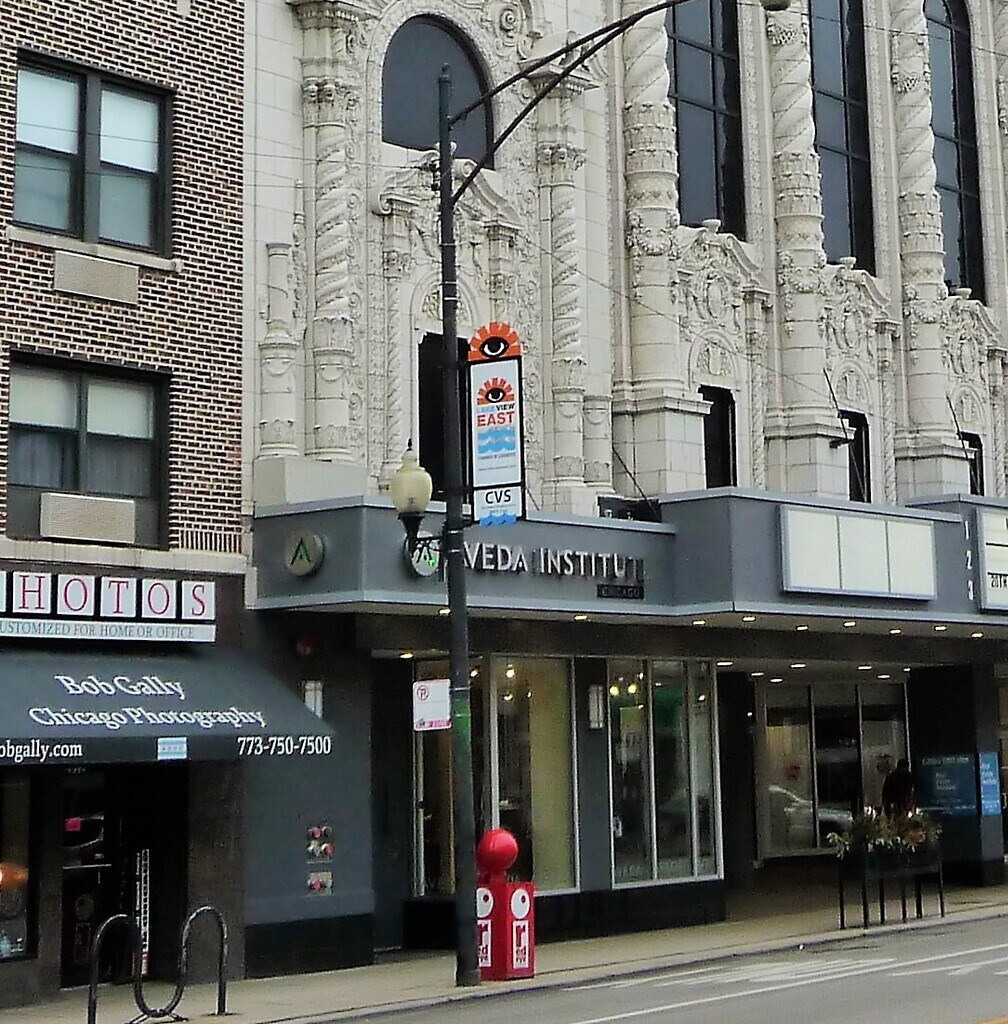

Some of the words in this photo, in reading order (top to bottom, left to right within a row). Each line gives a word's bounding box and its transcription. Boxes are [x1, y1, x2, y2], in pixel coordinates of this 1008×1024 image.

[477, 412, 515, 427] EAST
[485, 489, 511, 504] CVS
[463, 541, 529, 572] VEDA
[74, 623, 96, 636] FOR
[101, 624, 134, 637] HOME
[137, 625, 153, 637] OR
[156, 626, 195, 639] OFFICE
[54, 675, 116, 695] Bob
[113, 675, 185, 700] Gally
[28, 707, 128, 729] Chicago
[121, 706, 266, 728] Photography
[237, 735, 331, 756] 773-750-7500
